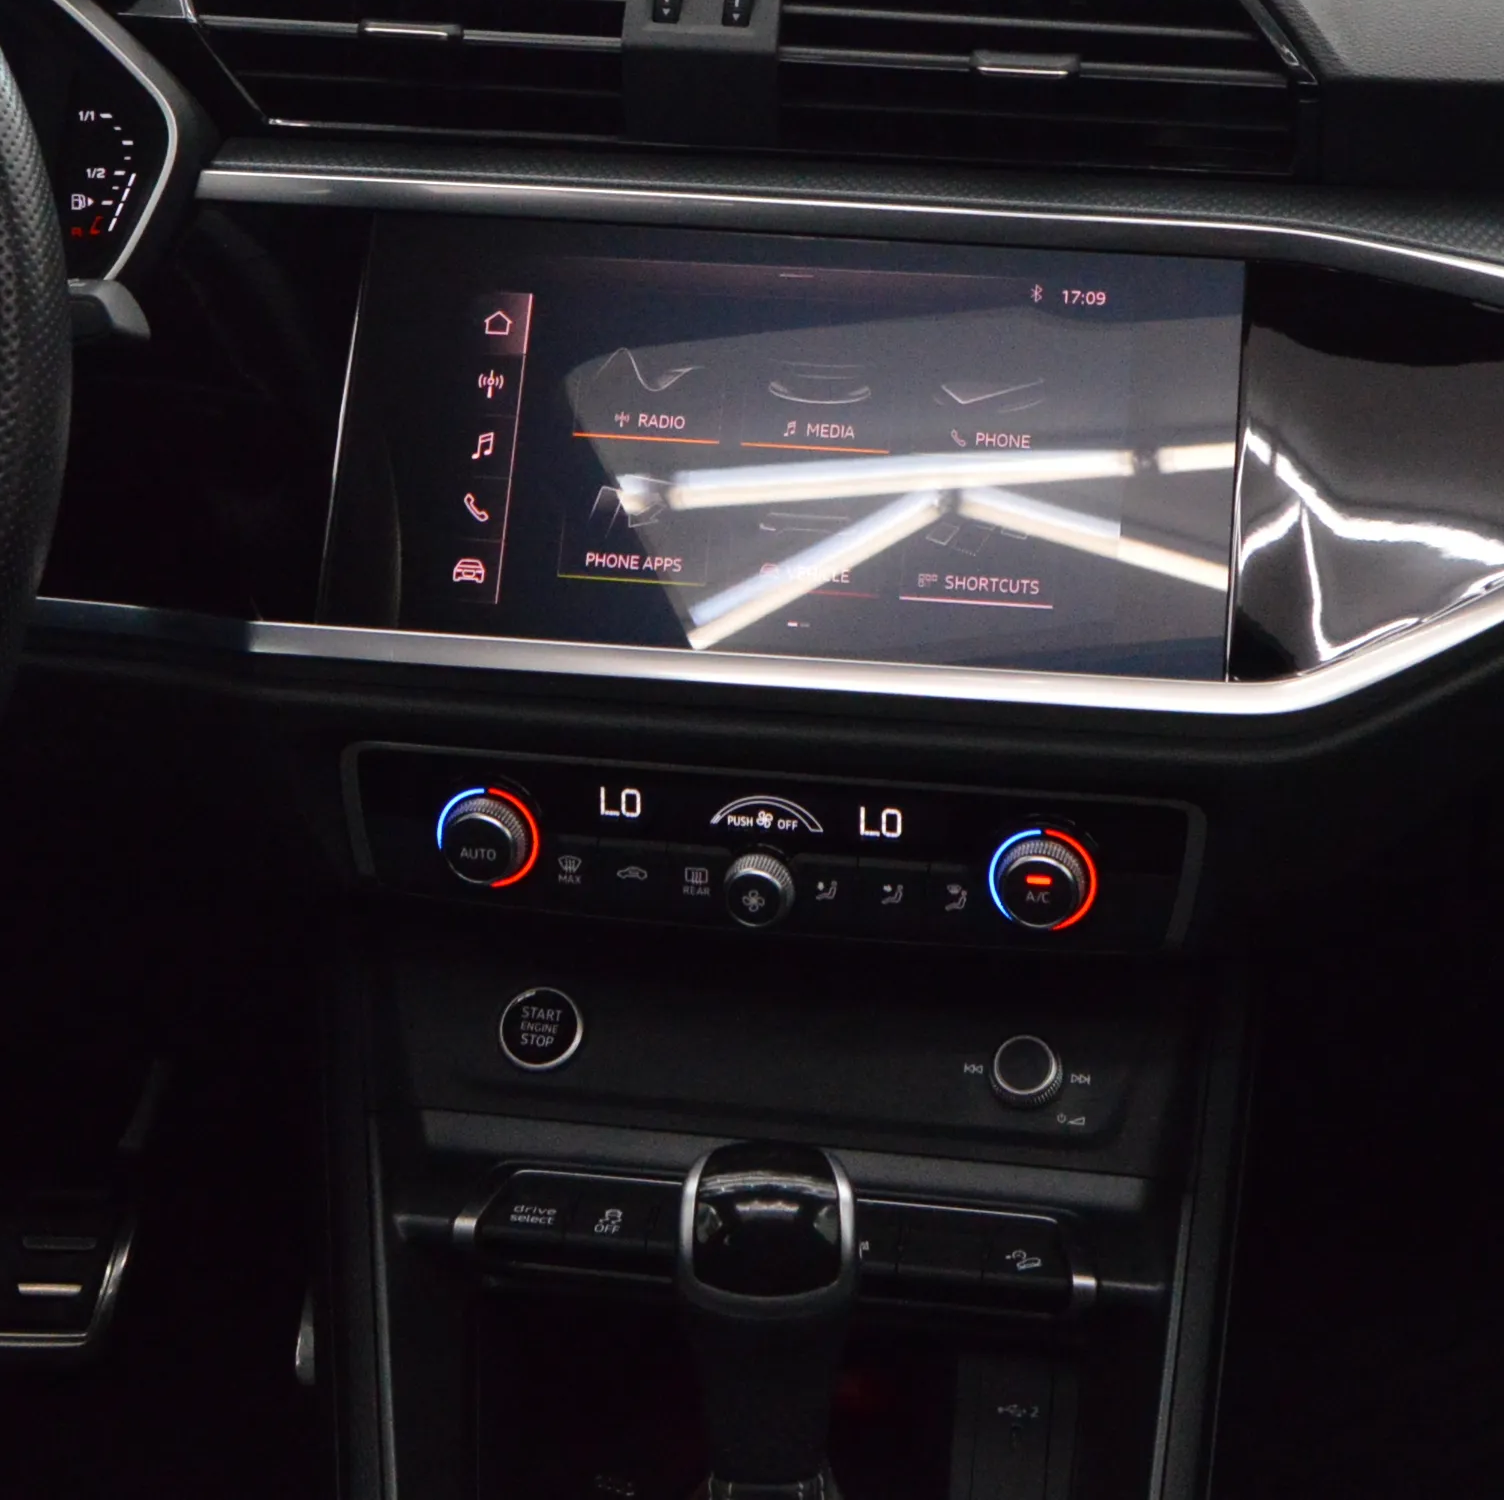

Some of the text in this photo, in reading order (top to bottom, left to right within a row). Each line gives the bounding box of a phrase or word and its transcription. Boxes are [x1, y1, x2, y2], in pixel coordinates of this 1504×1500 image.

[78, 110, 95, 122] 1/1
[86, 167, 106, 179] 1/2
[1062, 289, 1107, 306] 17:09
[637, 413, 686, 430] RADIO
[806, 423, 855, 439] MEDIA
[975, 432, 1032, 449] PHONE
[585, 551, 683, 573] PHONE APPS
[945, 575, 1040, 595] SHORTCUTS
[599, 786, 642, 818] LO
[727, 814, 799, 831] PUSH OFF
[859, 806, 902, 838] LO
[459, 847, 497, 861] AUTO
[558, 874, 582, 885] MAX
[682, 886, 711, 897] REAR
[1025, 890, 1051, 904] A/C
[521, 1005, 563, 1023] START
[520, 1021, 560, 1035] ENGINE
[520, 1032, 555, 1048] STOP
[513, 1204, 557, 1216] drive
[510, 1213, 554, 1225] select
[594, 1223, 621, 1234] OFF
